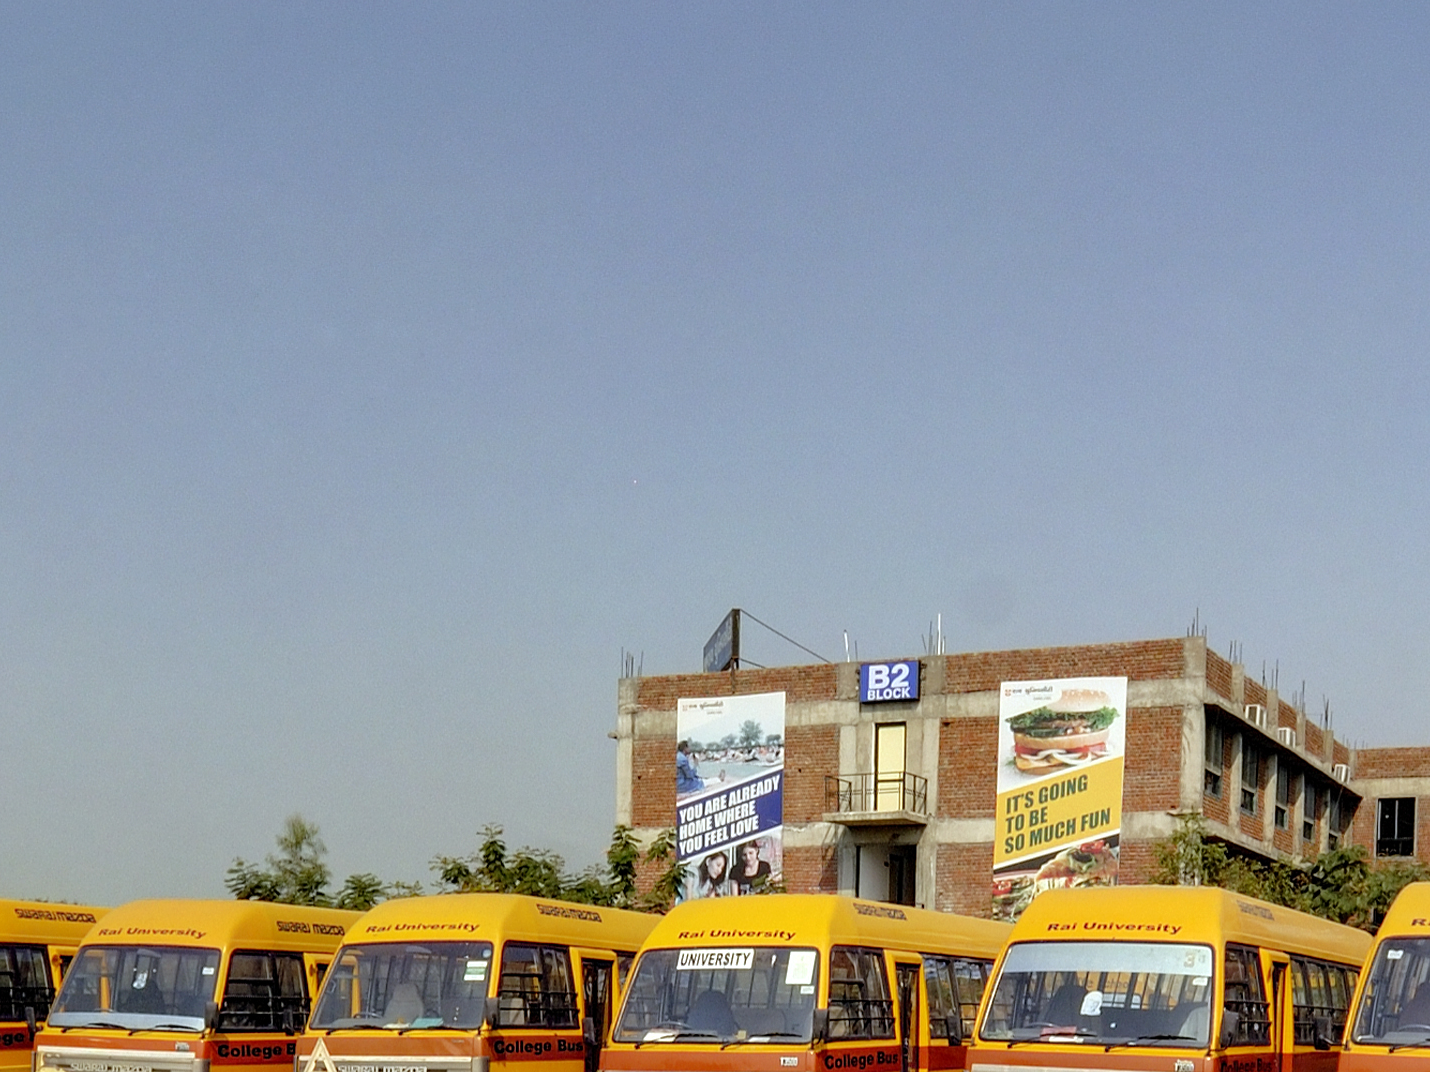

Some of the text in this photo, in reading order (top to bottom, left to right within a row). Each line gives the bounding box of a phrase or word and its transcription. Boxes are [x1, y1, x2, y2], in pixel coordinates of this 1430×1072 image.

[868, 663, 910, 690] B2
[867, 687, 911, 701] BLOCK
[679, 775, 780, 824] YOU ARE ALREADY
[1006, 774, 1088, 814] IT'S GOING
[679, 800, 756, 840] HOME WHERE
[1005, 806, 1048, 834] TO BE
[679, 815, 759, 856] YOU FEEL LOVE
[1005, 807, 1111, 854] SO MUCH FUN
[99, 927, 207, 940] Rai University
[366, 923, 480, 933] Rai University
[678, 929, 796, 941] Rai University
[1047, 922, 1182, 935] Rai University
[680, 951, 751, 966] UNIVERSITY
[217, 1043, 282, 1060] College
[494, 1039, 583, 1055] College Bus
[824, 1051, 899, 1070] College Bus
[1256, 1058, 1273, 1072] Bus
